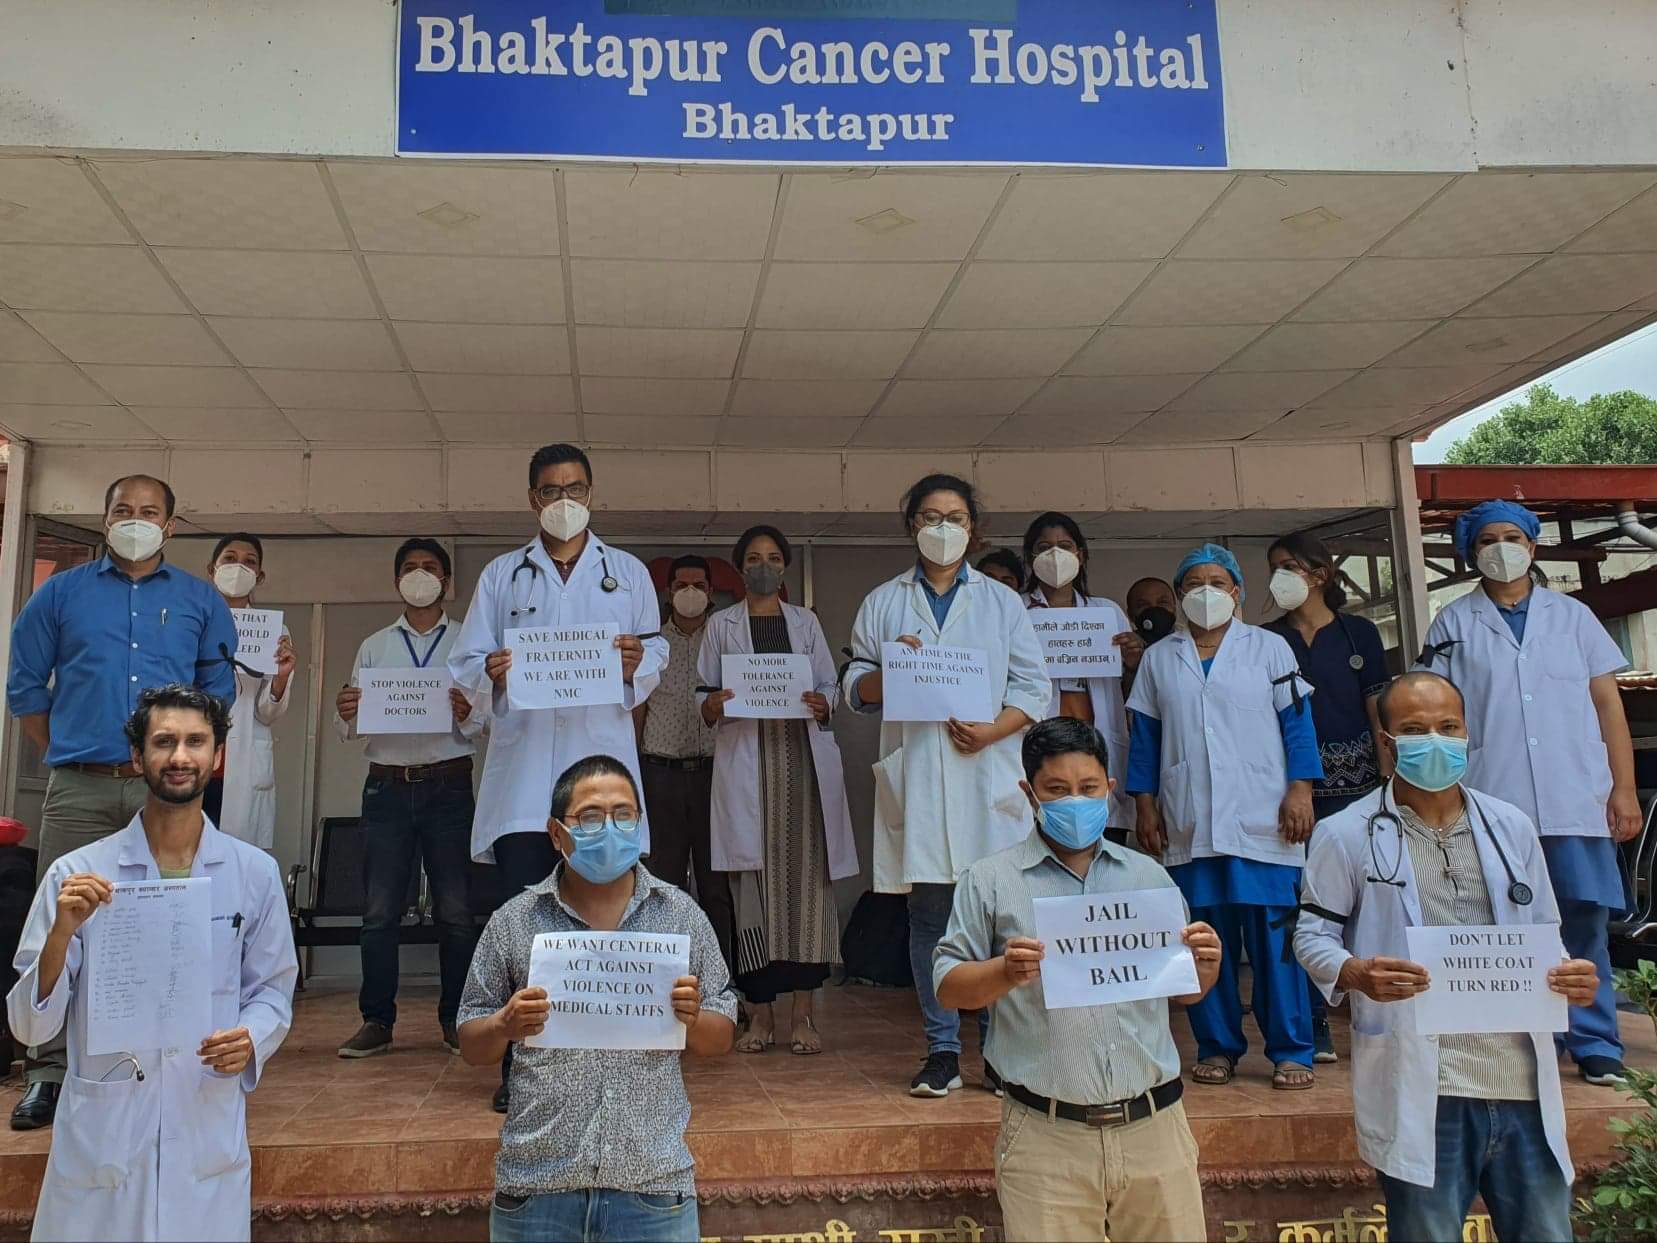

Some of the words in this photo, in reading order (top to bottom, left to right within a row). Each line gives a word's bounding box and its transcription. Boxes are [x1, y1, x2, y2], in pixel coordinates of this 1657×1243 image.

[415, 16, 727, 97] Bhaktapur
[748, 27, 951, 85] Cancer
[970, 28, 1209, 103] Hospital
[682, 102, 955, 151] Bhaktapur
[242, 613, 267, 623] THAT
[519, 632, 549, 643] SAVE
[554, 630, 608, 641] MEDICAL
[526, 649, 601, 663] FRATERNITY
[748, 658, 761, 666] NO
[763, 658, 787, 666] MORE
[944, 650, 953, 659] IS
[954, 652, 974, 661] THE
[524, 671, 543, 682] WE
[547, 670, 570, 681] ARE
[574, 668, 606, 680] WITH
[888, 661, 918, 671] RIGHT
[920, 661, 945, 671] TIME
[946, 664, 984, 676] AGAINST
[743, 672, 793, 680] TOLERANCE
[914, 675, 961, 685] INJUSTICE
[370, 680, 395, 689] STOP
[397, 680, 442, 689] VIOLENCE
[750, 685, 787, 693] AGAINST
[386, 693, 425, 702] AGAINST
[554, 687, 581, 698] NMC
[744, 699, 790, 707] VIOLENCE
[384, 707, 427, 716] DOCTORS
[1085, 903, 1138, 923] JAIL
[1055, 931, 1171, 955] WITHOUT
[1450, 933, 1494, 946] DON'T
[1498, 934, 1526, 945] LET
[543, 939, 564, 950] WE
[567, 940, 605, 951] WANT
[609, 940, 681, 955] CENTERAL
[564, 959, 592, 972] ACT
[595, 961, 655, 974] AGAINST
[1443, 957, 1491, 968] WHITE
[1495, 957, 1535, 968] COAT
[1089, 965, 1148, 986] BAIL
[563, 979, 632, 995] VIOLENCE
[634, 983, 655, 995] ON
[1447, 980, 1486, 992] TURN
[1490, 980, 1520, 992] RED
[550, 1001, 613, 1016] MEDICAL
[616, 1003, 664, 1016] STAFFS
